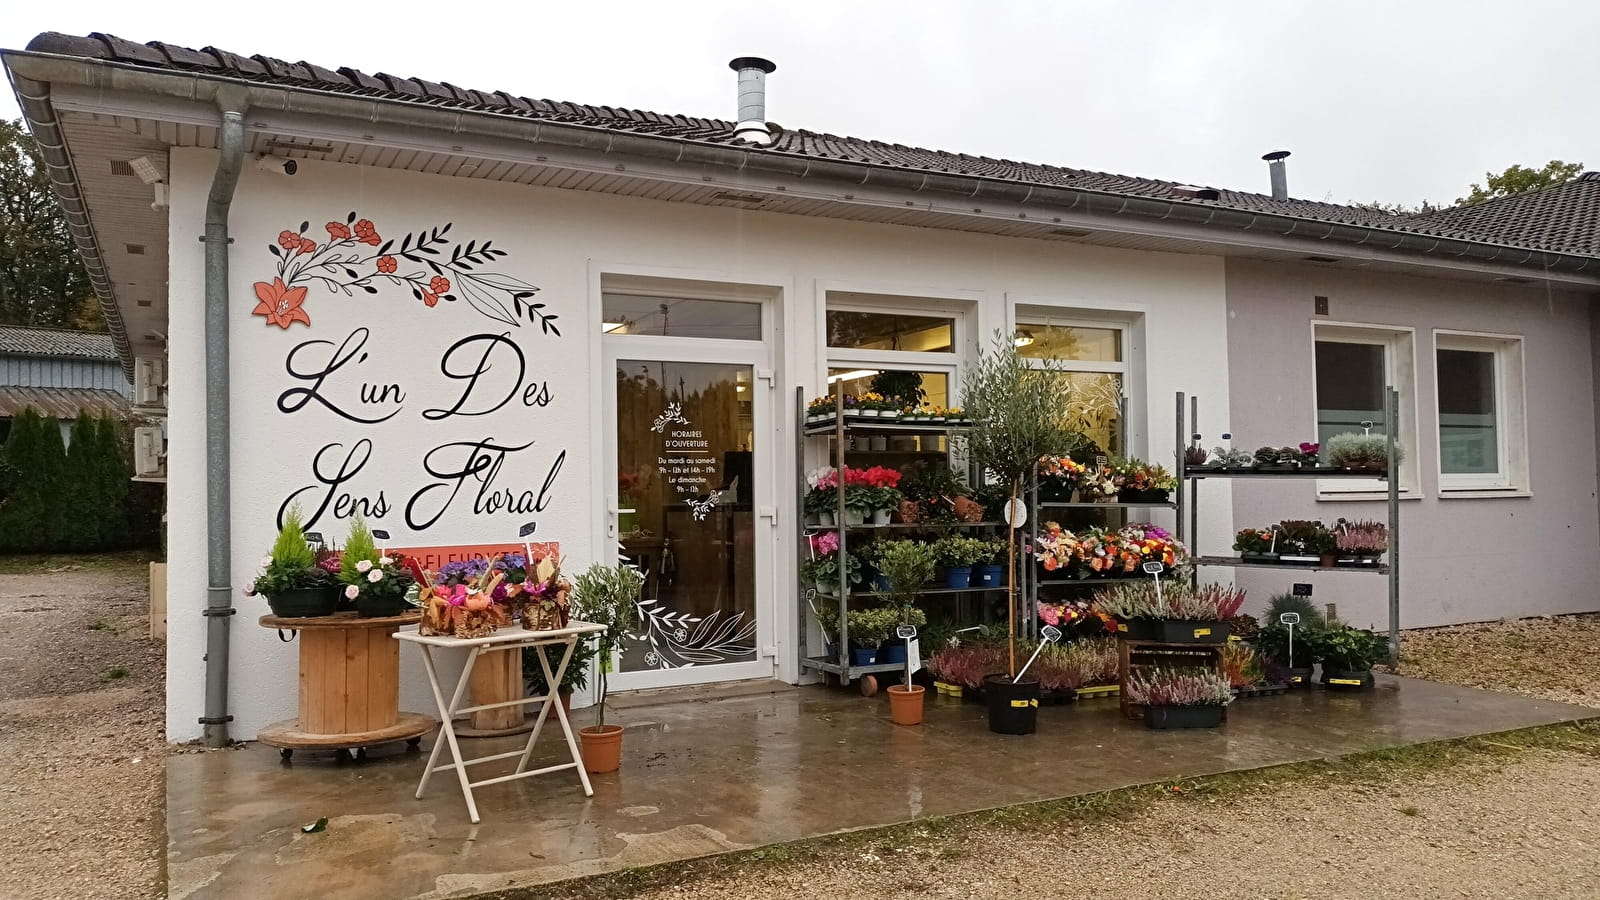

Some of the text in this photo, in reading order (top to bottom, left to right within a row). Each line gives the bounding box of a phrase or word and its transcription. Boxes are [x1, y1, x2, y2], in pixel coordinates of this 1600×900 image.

[277, 327, 554, 424] L'un Des
[671, 430, 702, 438] HORAIRES
[658, 456, 667, 464] Du
[667, 456, 685, 464] mardi
[658, 466, 667, 474] 9h
[277, 437, 566, 533] Sens Floral
[676, 485, 685, 493] 9h
